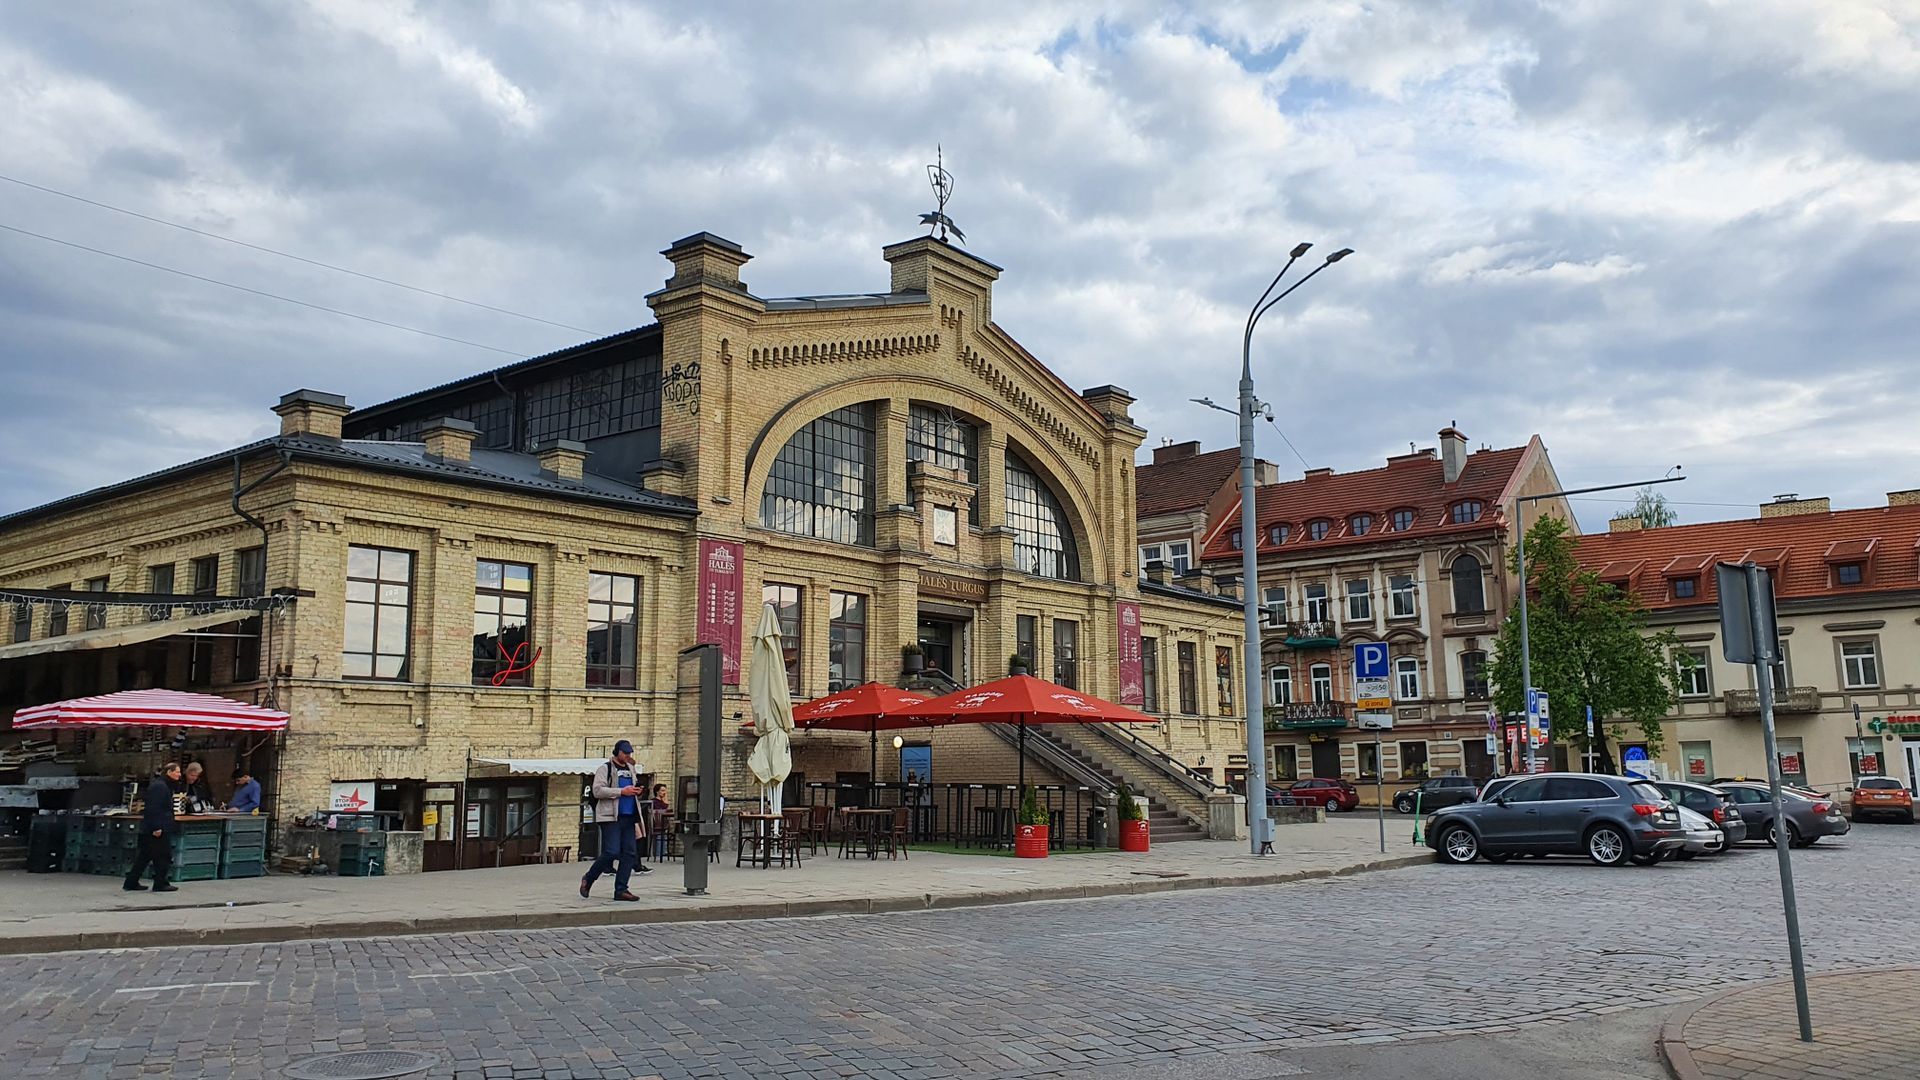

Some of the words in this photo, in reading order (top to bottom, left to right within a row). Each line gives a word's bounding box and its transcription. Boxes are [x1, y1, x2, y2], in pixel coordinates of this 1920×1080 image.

[949, 579, 985, 595] TURGUS
[1363, 646, 1382, 674] P
[1530, 691, 1536, 712] P
